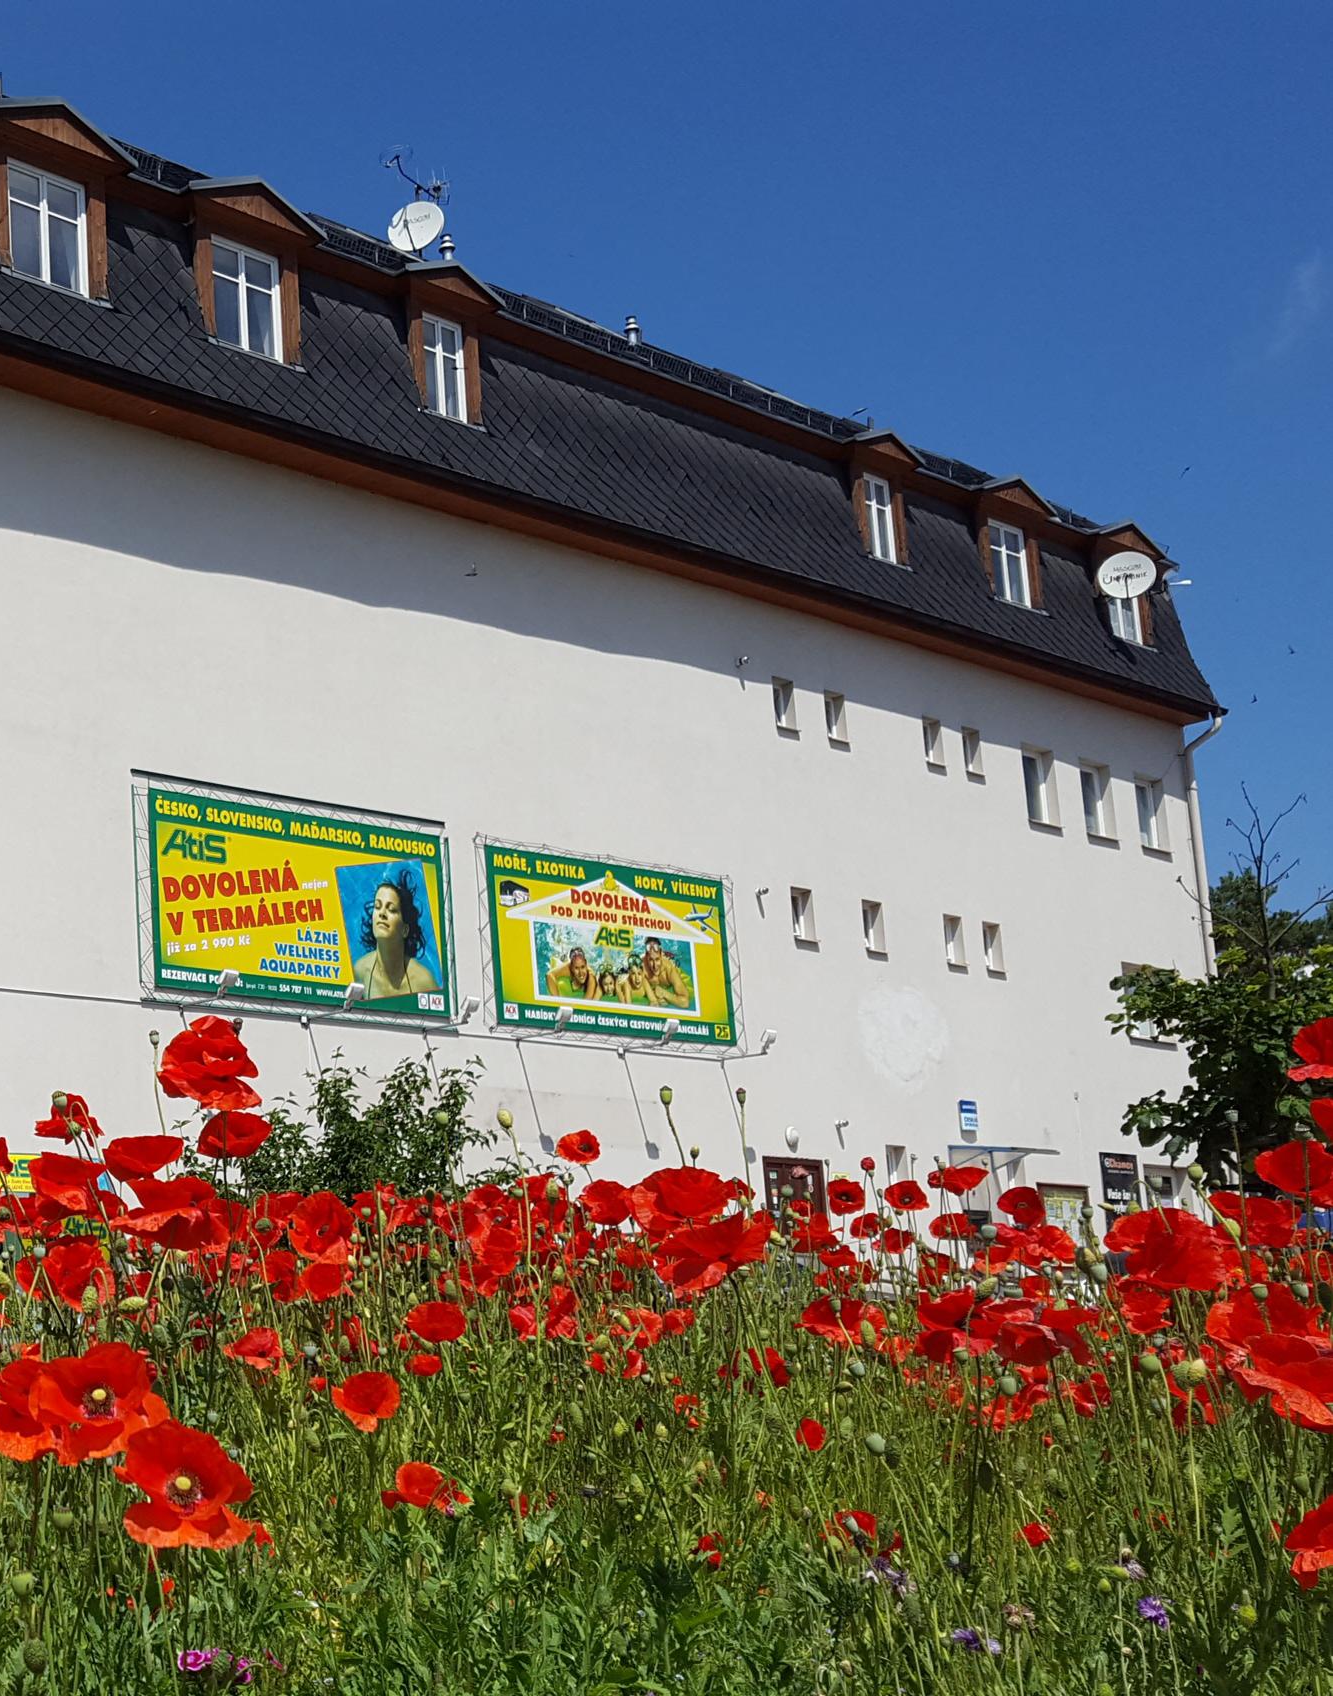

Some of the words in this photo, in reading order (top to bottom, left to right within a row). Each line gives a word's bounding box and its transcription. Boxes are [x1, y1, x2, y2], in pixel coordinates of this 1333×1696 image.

[155, 795, 202, 822] ČESKO,
[206, 807, 286, 836] SLOVENSKO,
[290, 821, 365, 848] MAĎARSKO,
[369, 834, 436, 857] RAKOUSKO
[161, 828, 227, 865] AtiS
[493, 854, 532, 874] MOŘE,
[535, 860, 586, 880] EXOTIKA
[162, 859, 299, 902] DOVOLENÁ
[301, 879, 329, 891] nejen
[634, 875, 667, 894] HORY,
[671, 879, 717, 899] VÍKENDY
[570, 888, 651, 914] DOVOLENÁ
[166, 912, 184, 936] V
[193, 897, 324, 933] TERMÁLECH
[550, 905, 573, 917] POD
[577, 909, 618, 924] JEDNOU
[622, 913, 671, 931] STŘECHOU
[184, 943, 197, 952] za
[201, 939, 209, 950] 2
[213, 937, 235, 948] 990
[594, 926, 632, 948] AtiS
[274, 943, 340, 962] WELLNESS
[161, 969, 207, 983] REZERVACE
[259, 958, 341, 980] AQUAPARKY
[598, 1015, 628, 1028] ČESKÝCH
[677, 1024, 710, 1036] ANCELÁŘÍ
